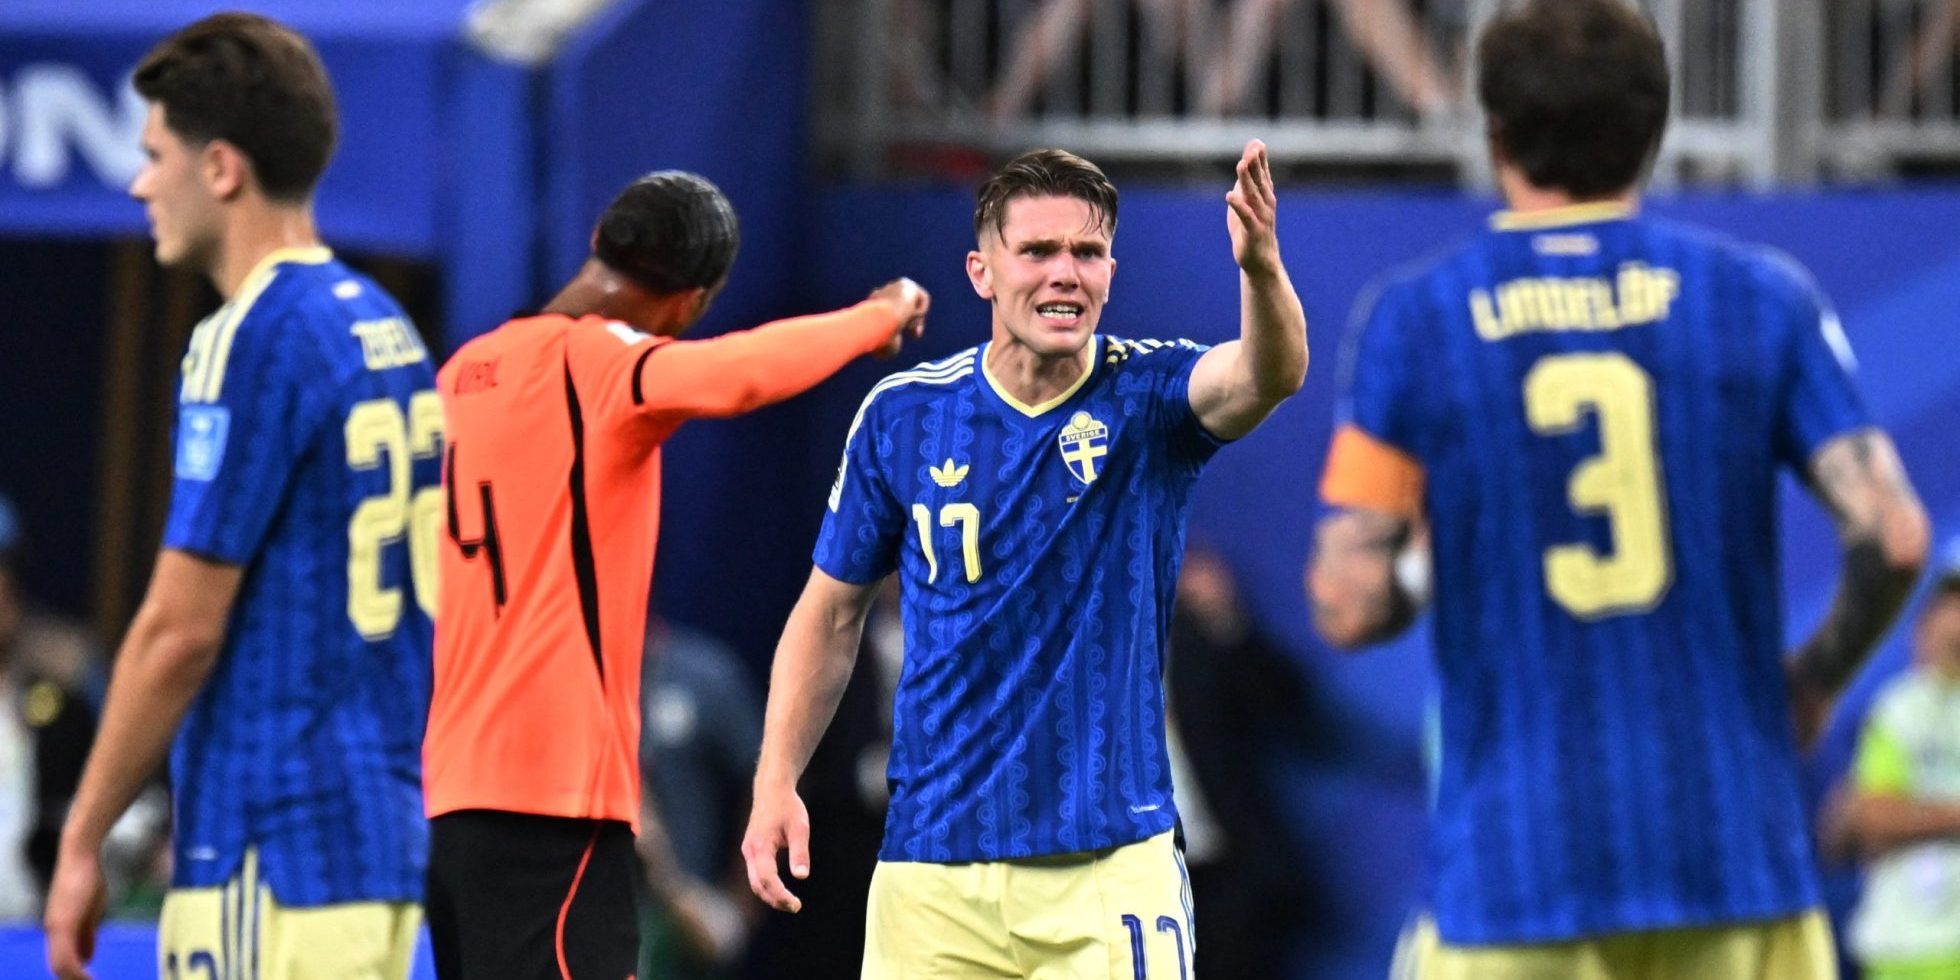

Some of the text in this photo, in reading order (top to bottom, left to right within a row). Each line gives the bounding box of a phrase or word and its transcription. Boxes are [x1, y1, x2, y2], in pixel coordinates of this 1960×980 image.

[0, 62, 148, 190] N
[1065, 429, 1100, 442] SVERIGE
[1523, 352, 1675, 622] 3
[447, 441, 507, 622] 4
[912, 503, 983, 584] 17
